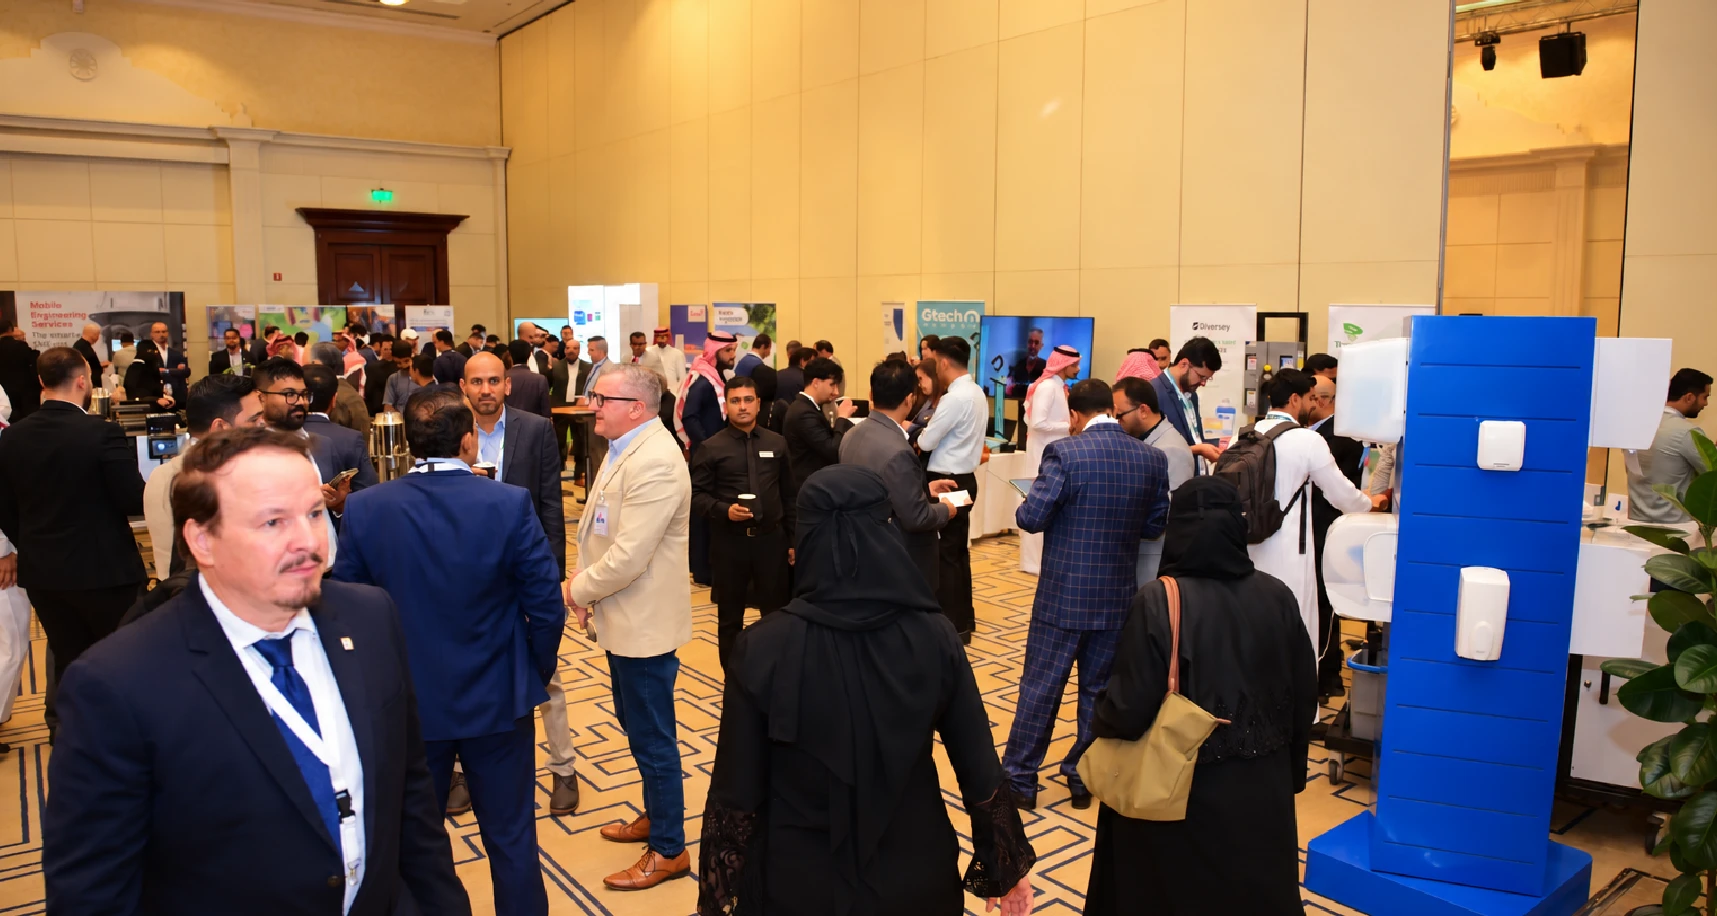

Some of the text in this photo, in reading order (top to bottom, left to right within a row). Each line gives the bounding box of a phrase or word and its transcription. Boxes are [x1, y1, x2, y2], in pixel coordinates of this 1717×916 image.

[30, 311, 87, 321] Engineering
[921, 308, 962, 322] Gtech
[1200, 322, 1231, 332] Diversey
